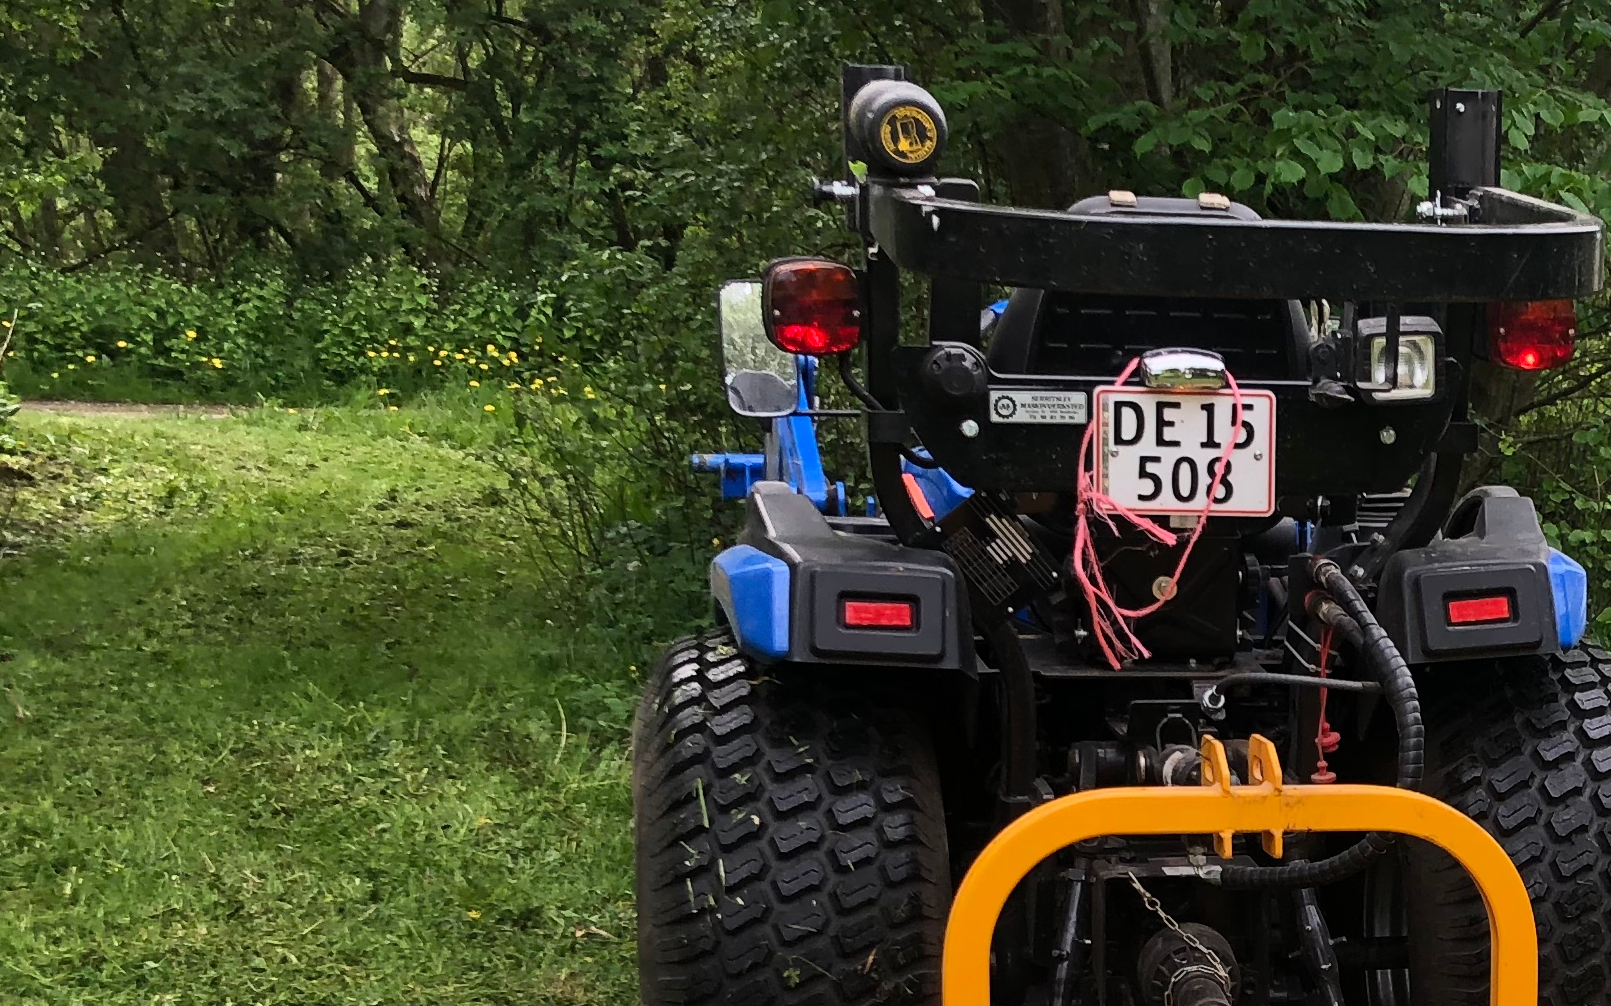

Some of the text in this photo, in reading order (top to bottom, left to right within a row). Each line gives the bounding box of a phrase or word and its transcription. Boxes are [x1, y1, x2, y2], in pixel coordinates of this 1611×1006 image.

[1113, 401, 1255, 449] DE 15
[1137, 455, 1234, 504] 508
